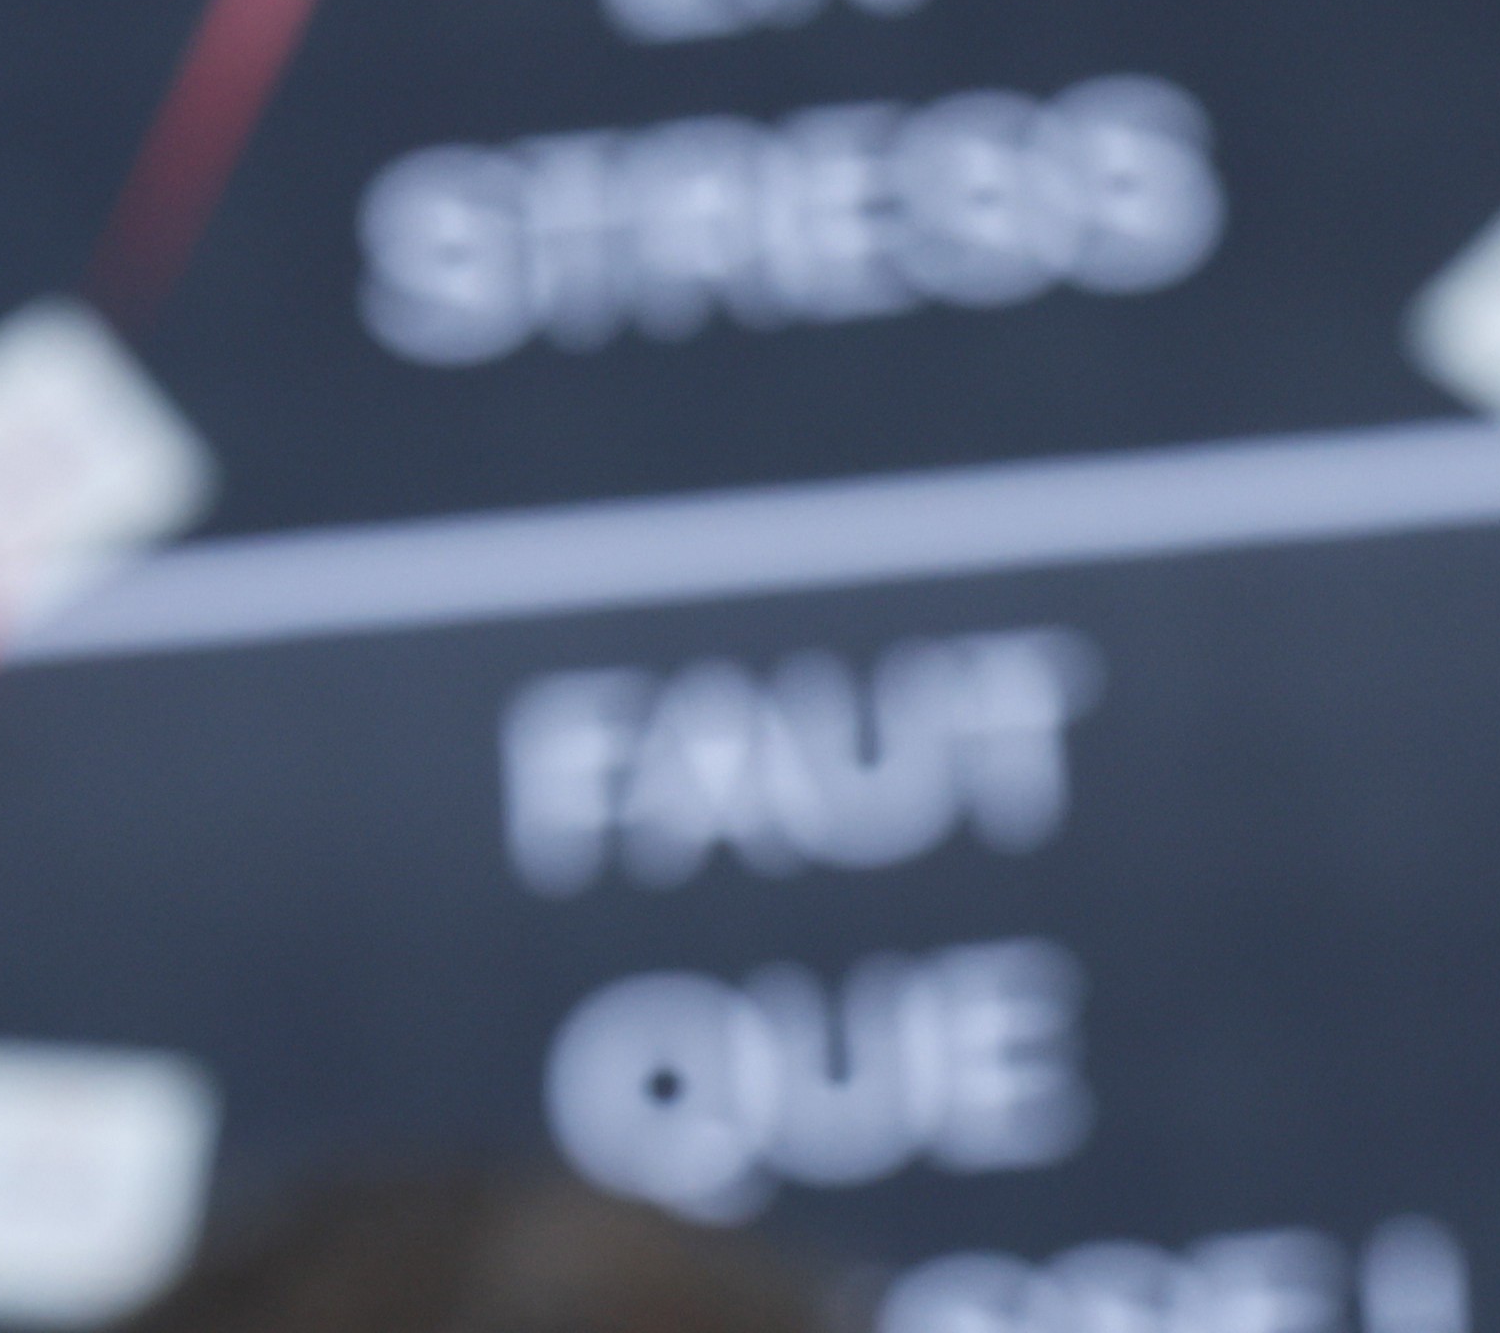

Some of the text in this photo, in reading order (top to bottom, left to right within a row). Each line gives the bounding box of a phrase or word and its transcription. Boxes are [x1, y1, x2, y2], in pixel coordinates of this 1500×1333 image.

[358, 75, 1225, 366] STRESS
[503, 627, 1100, 896] FAUT
[544, 939, 1090, 1225] QUE
